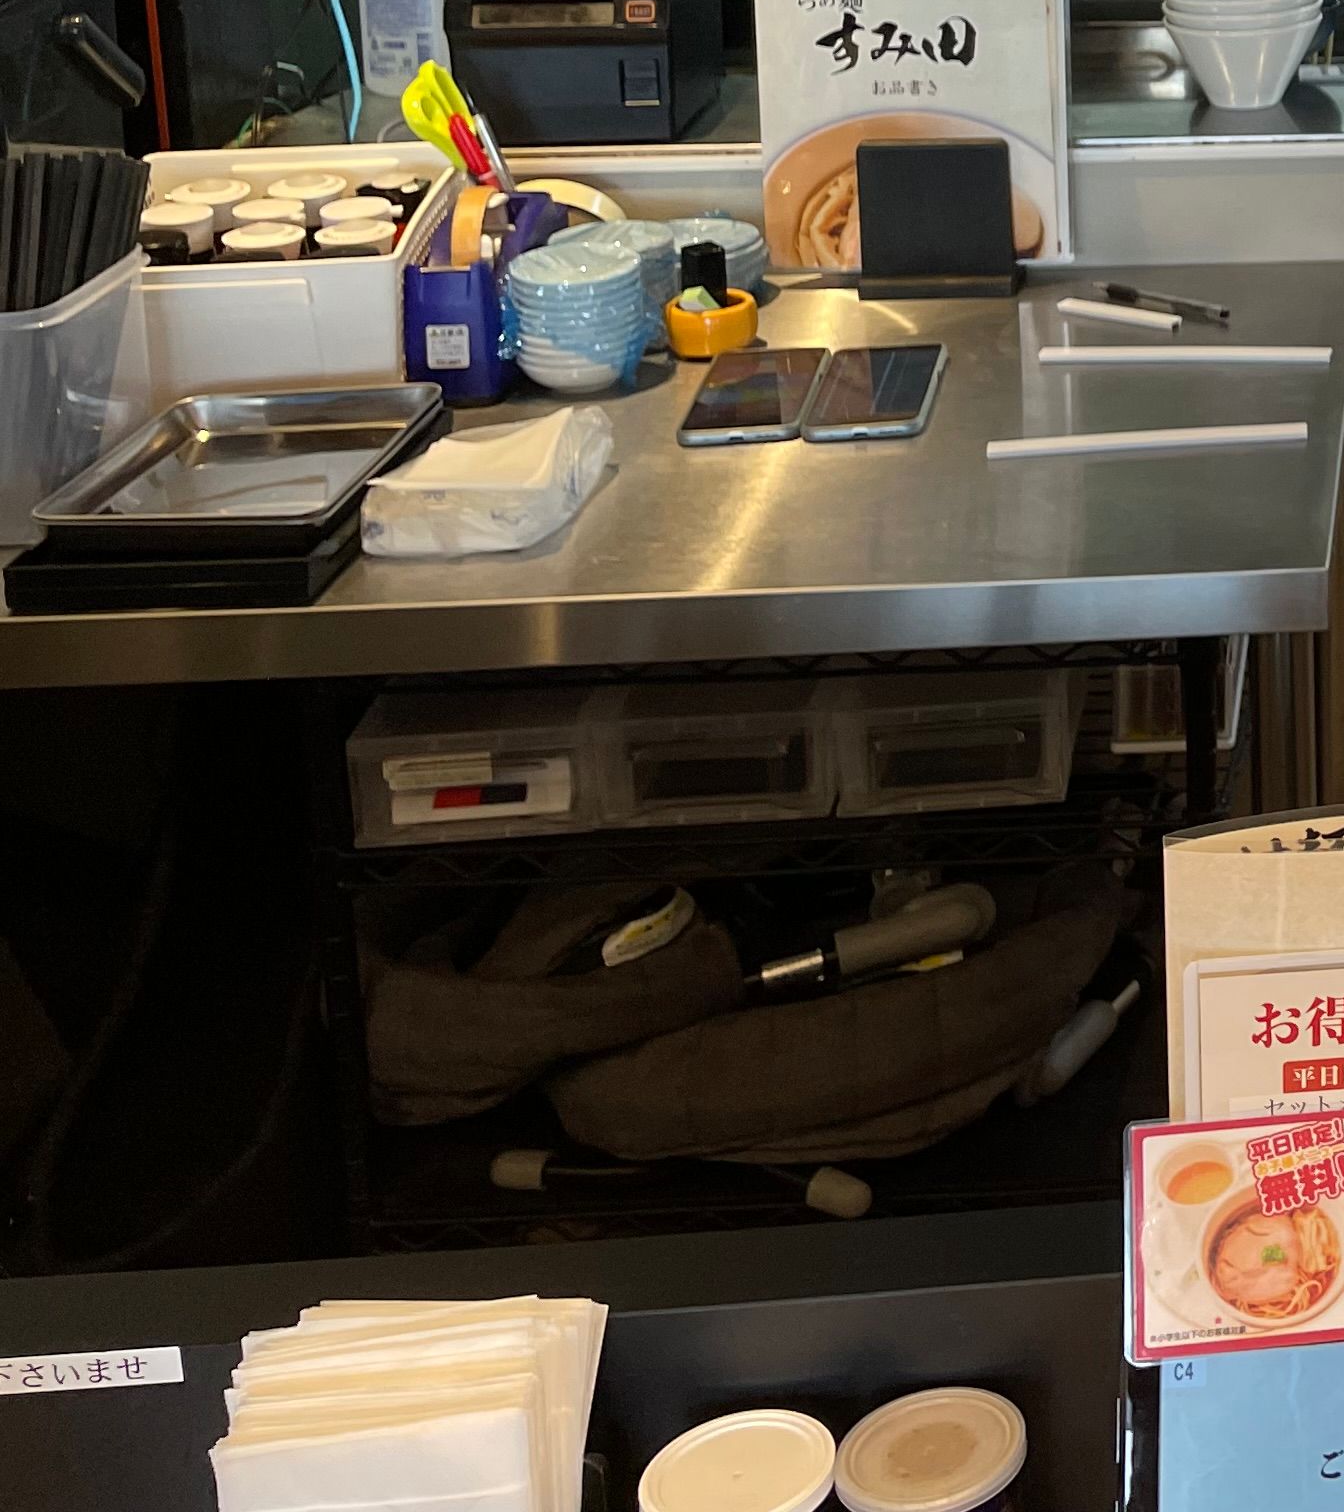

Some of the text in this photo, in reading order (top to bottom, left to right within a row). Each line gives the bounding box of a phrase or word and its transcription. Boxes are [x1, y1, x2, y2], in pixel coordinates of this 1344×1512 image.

[816, 12, 976, 76] すみ田
[1174, 1361, 1194, 1381] C4
